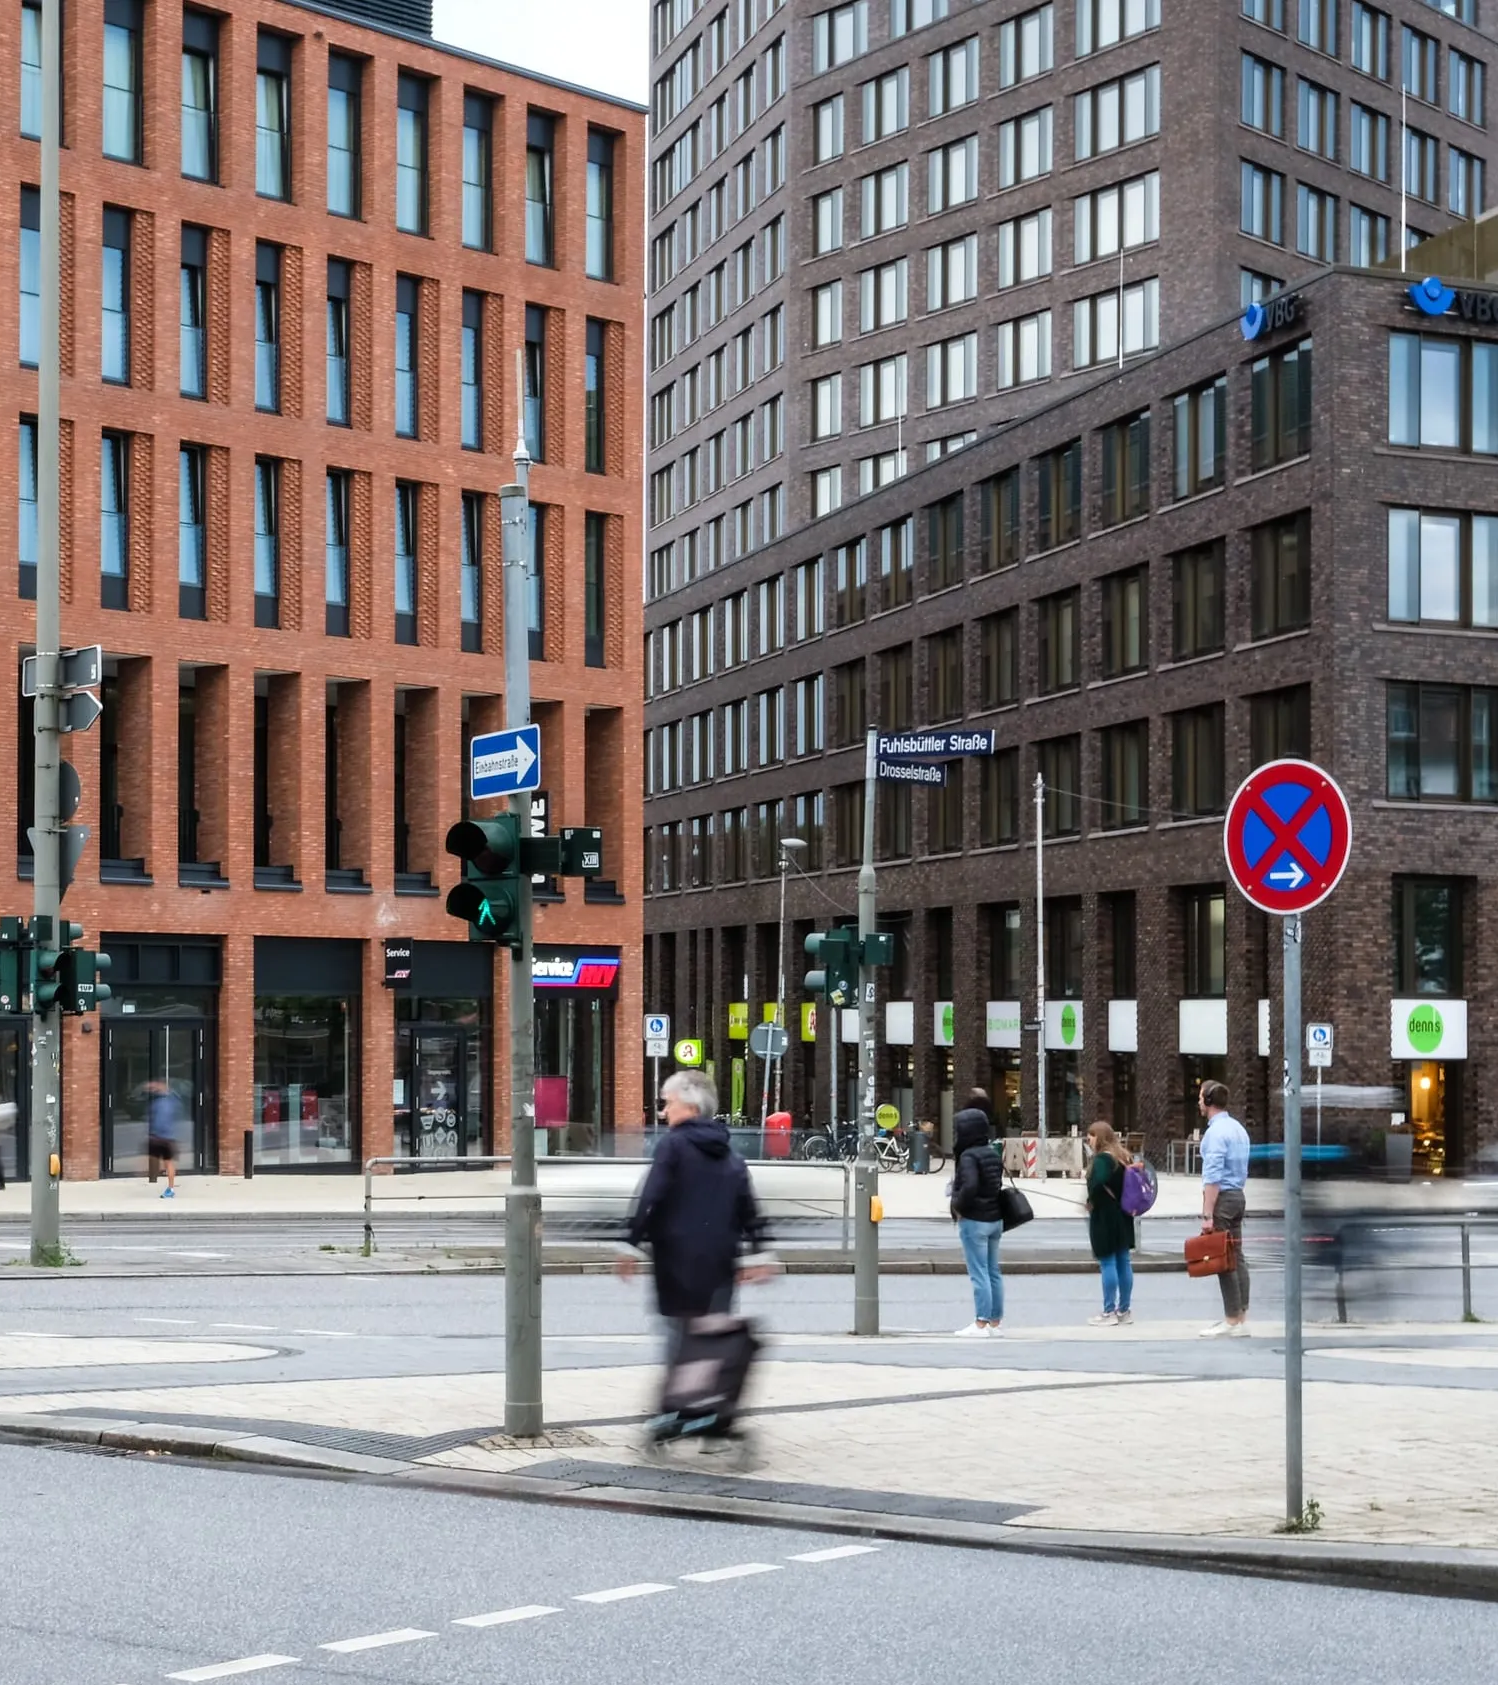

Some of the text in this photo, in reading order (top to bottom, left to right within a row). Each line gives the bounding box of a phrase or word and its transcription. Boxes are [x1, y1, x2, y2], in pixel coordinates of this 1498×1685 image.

[879, 733, 988, 754] Fuhlsbüttler Straße
[475, 753, 519, 775] Einbahnstraße
[879, 761, 942, 783] Drosselstraße
[386, 948, 410, 957] Service
